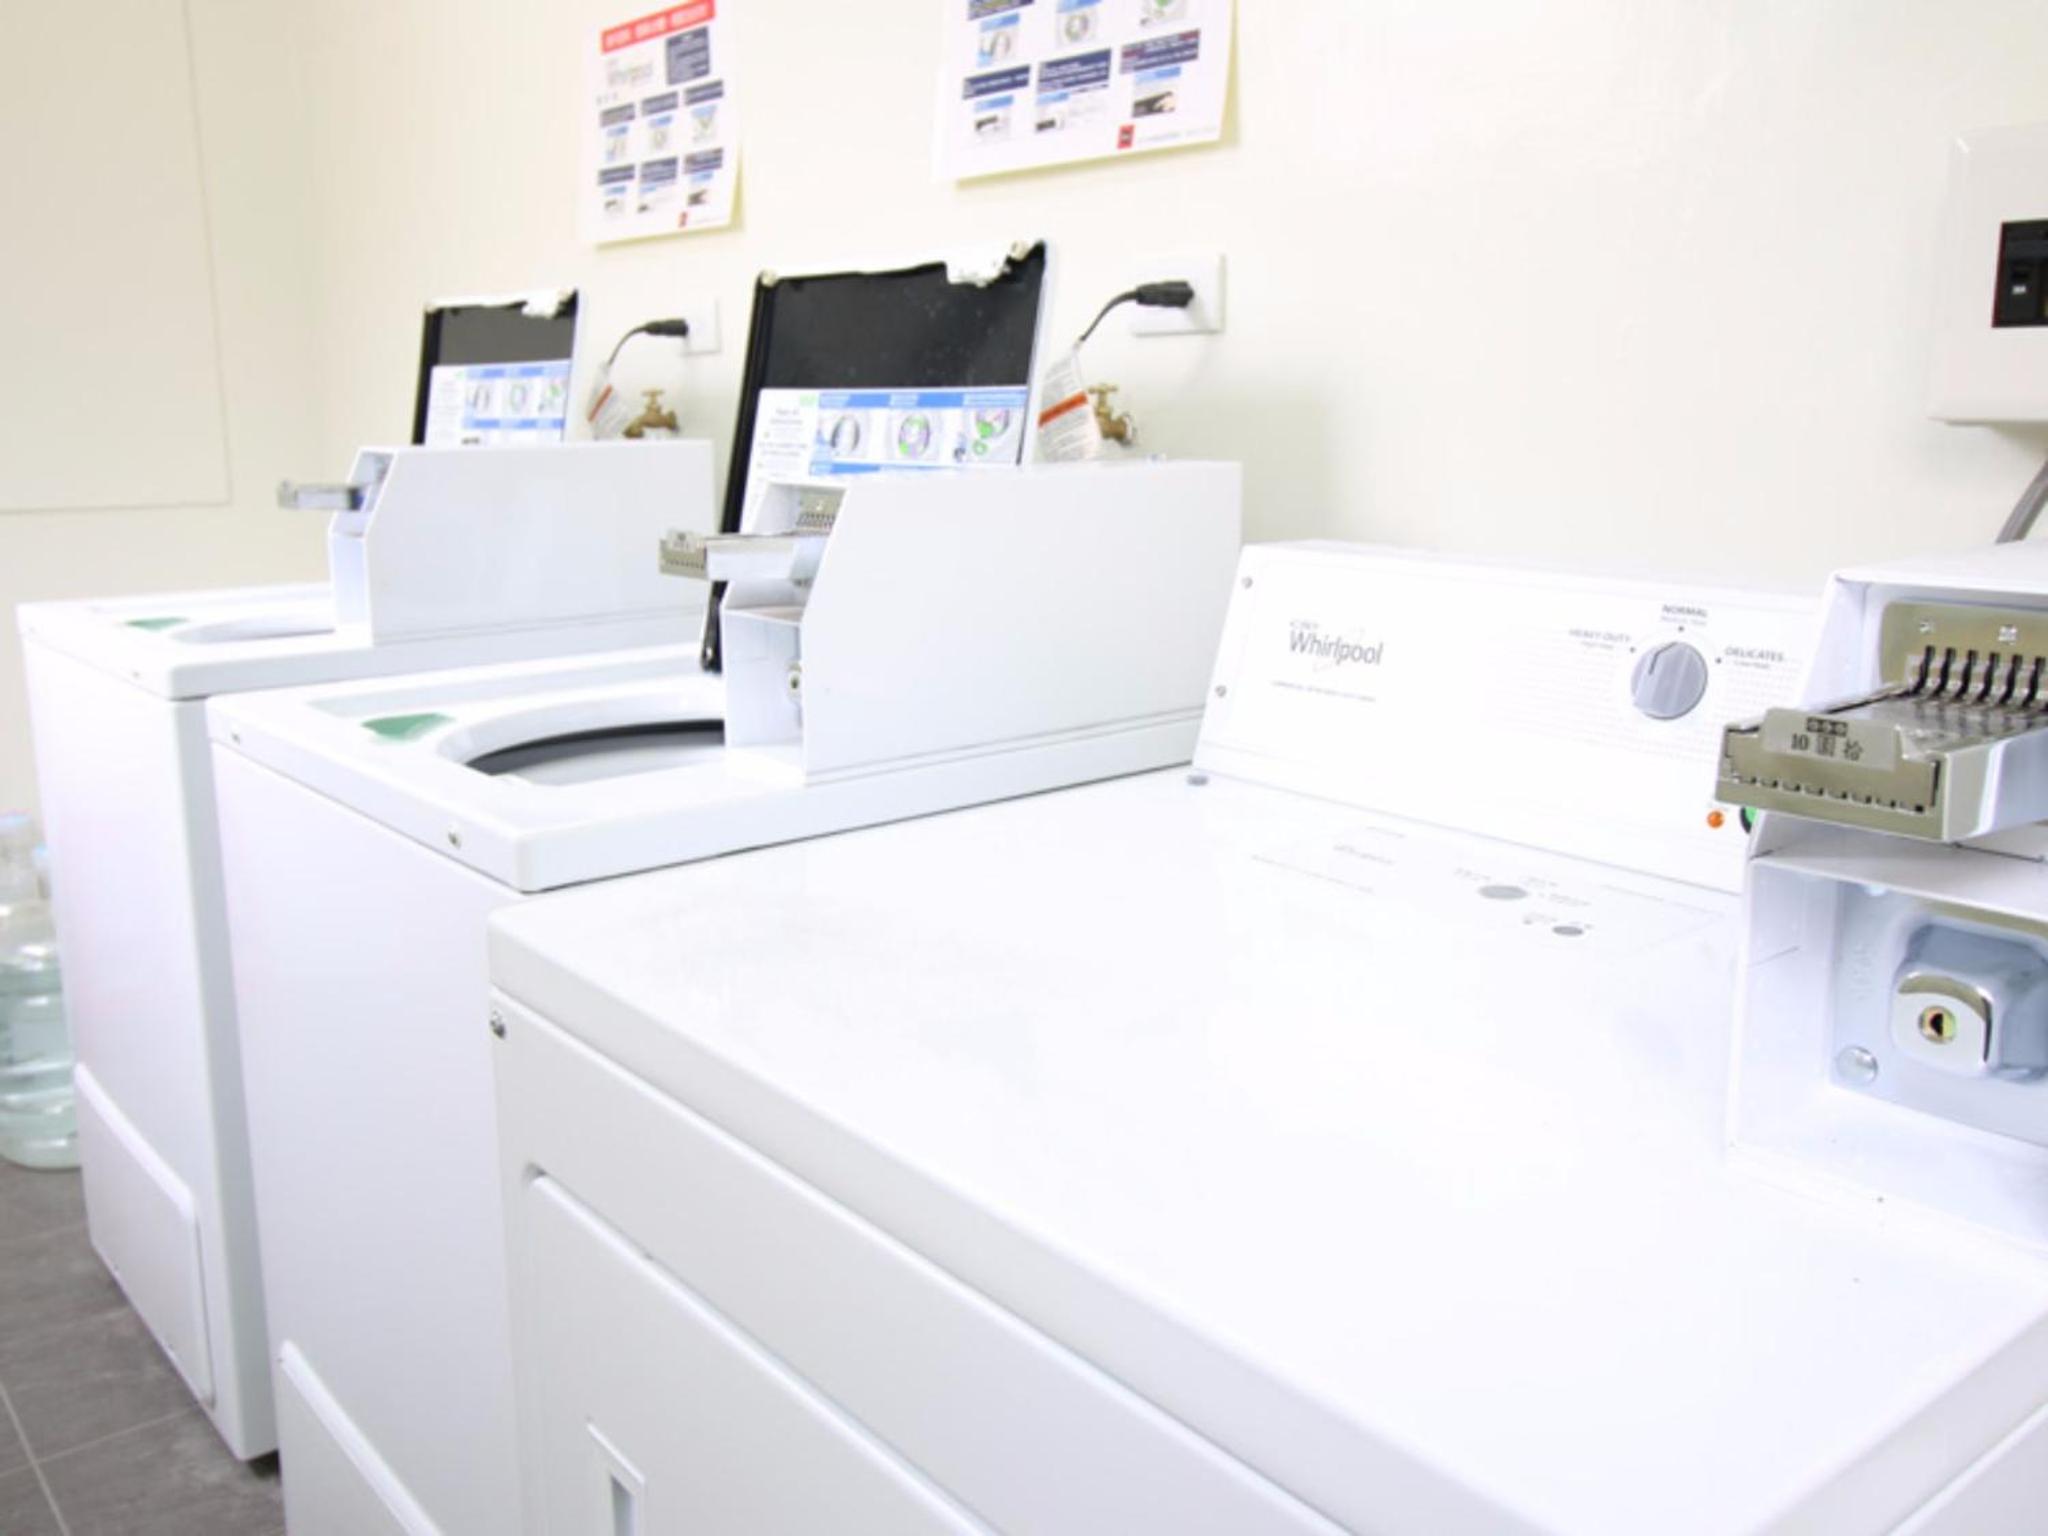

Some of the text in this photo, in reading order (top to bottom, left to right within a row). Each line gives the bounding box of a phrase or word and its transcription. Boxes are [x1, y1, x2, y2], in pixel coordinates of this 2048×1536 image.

[1662, 604, 1708, 618] NORMAL
[1569, 628, 1632, 643] HEAVY DUTY
[1289, 630, 1384, 666] Whirlpool
[1724, 646, 1784, 662] DELICATES
[1791, 733, 1809, 751] 10
